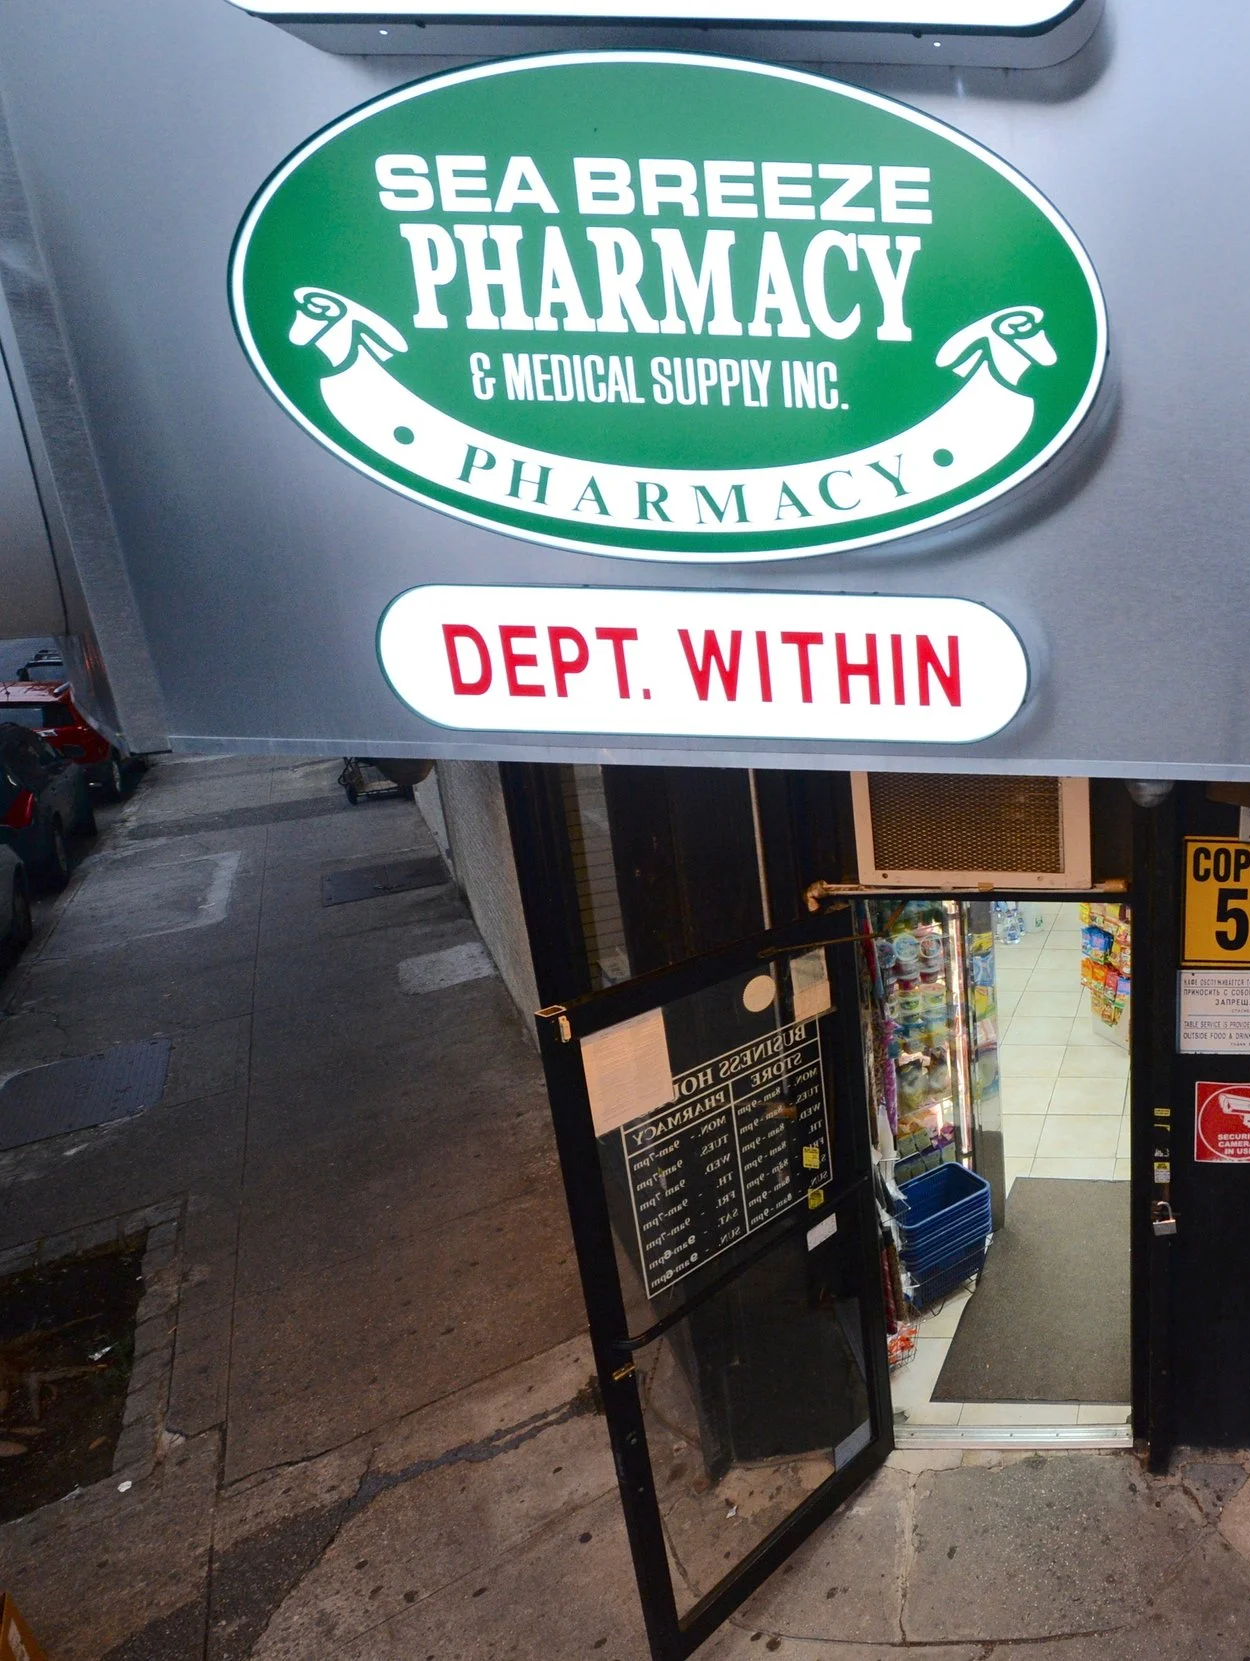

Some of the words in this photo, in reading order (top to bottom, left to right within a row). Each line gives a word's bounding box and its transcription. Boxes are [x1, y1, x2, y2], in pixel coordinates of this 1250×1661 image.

[374, 154, 558, 214] SEA
[574, 157, 934, 225] BREEZE
[400, 223, 922, 342] PHARMACY
[471, 353, 496, 400] &
[504, 354, 646, 405] MEDICAL
[651, 358, 771, 408] SUPPLY
[781, 361, 849, 411] INC.
[454, 442, 913, 525] PHARMACY
[441, 624, 652, 701] DEPT.
[676, 628, 963, 707] WITHIN
